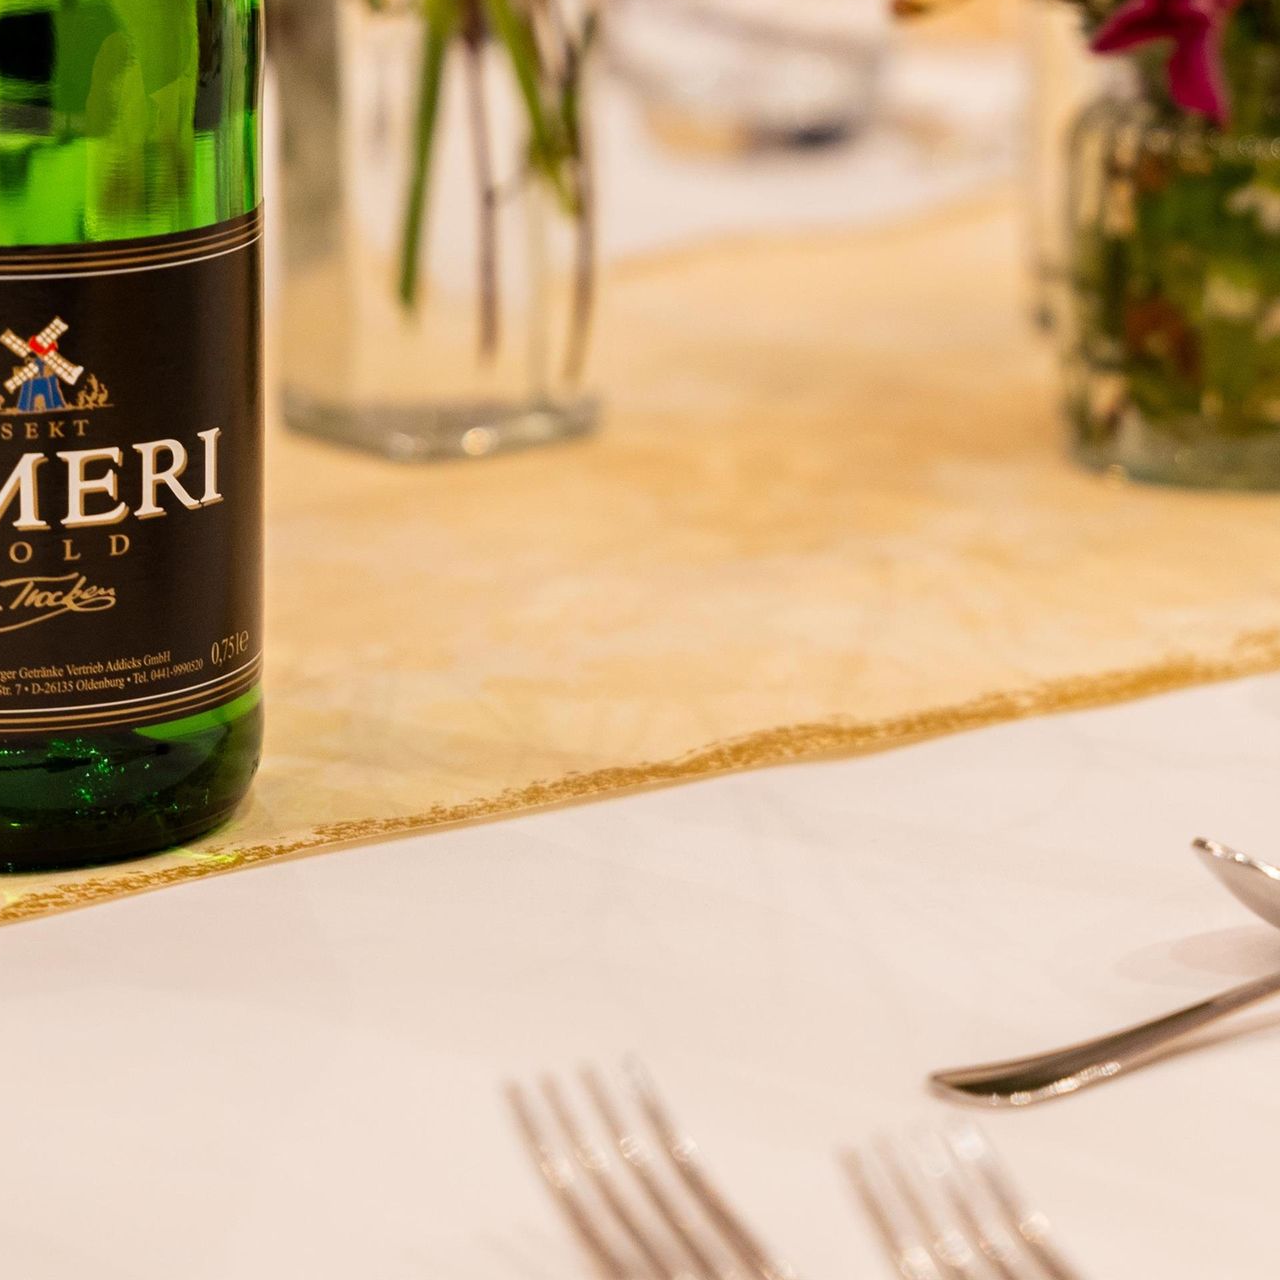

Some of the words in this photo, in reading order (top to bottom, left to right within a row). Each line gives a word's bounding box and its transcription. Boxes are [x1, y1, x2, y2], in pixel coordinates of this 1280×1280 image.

[0, 419, 91, 441] SEKT
[19, 666, 64, 680] Getränke
[66, 661, 104, 676] Vertrieb
[105, 655, 142, 672] Addicks
[143, 650, 171, 666] GmbH
[15, 683, 22, 695] 7
[31, 680, 74, 695] D-26135
[75, 676, 126, 691] Oldenburg
[133, 672, 150, 684] Tel.
